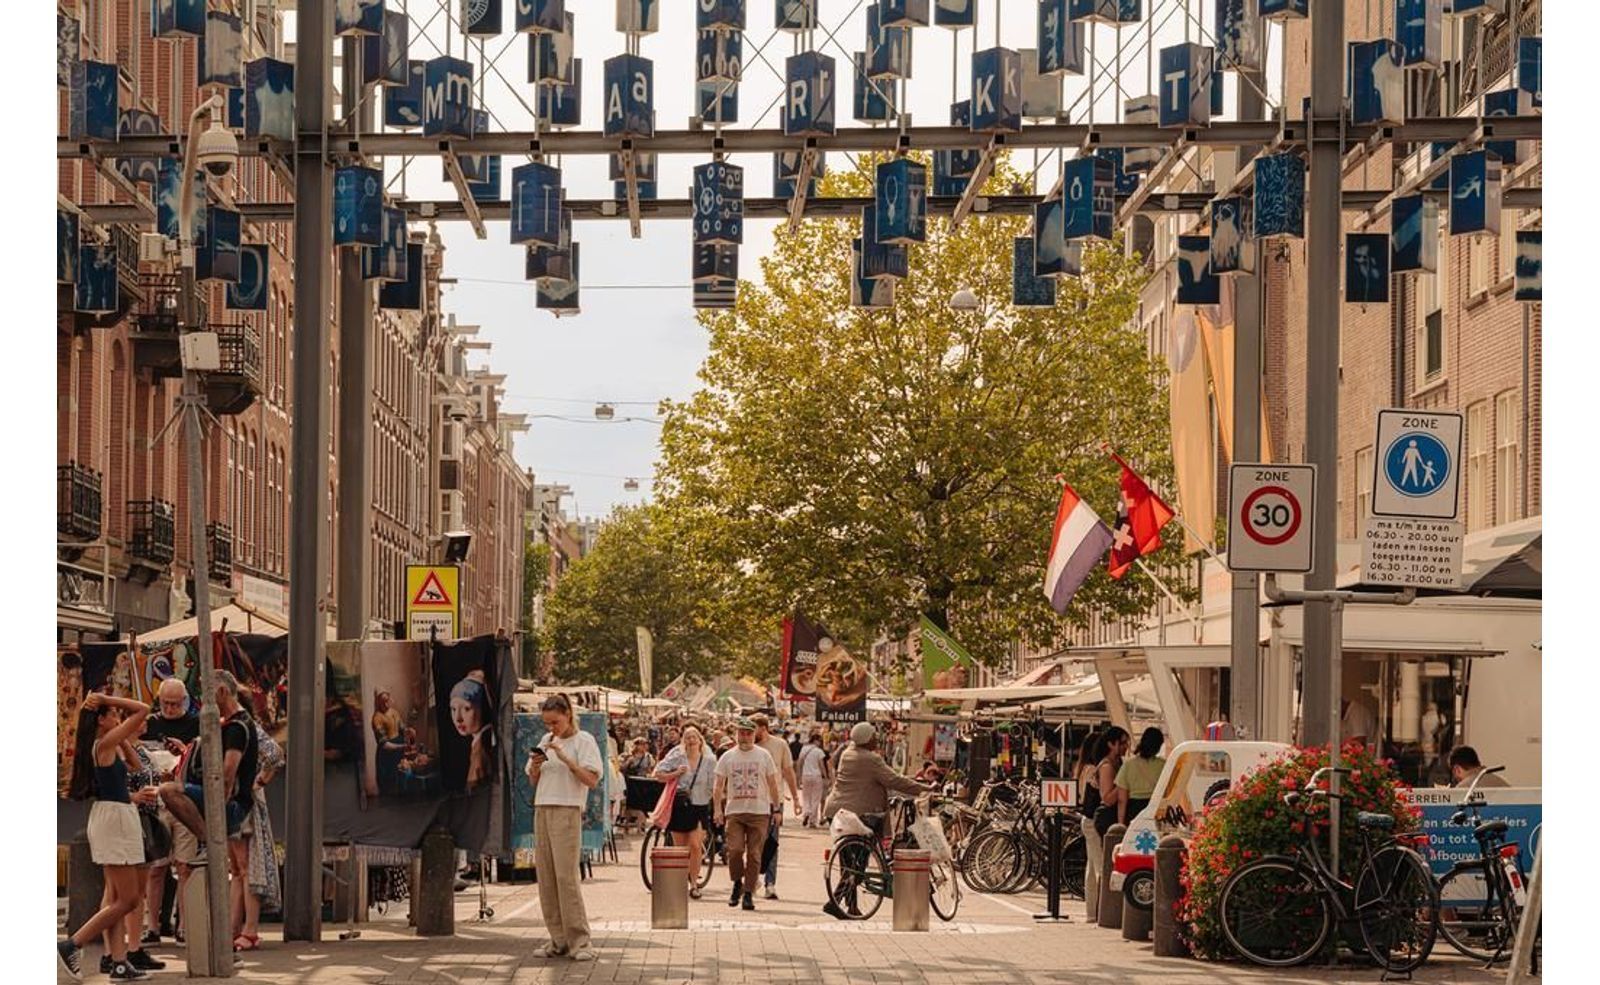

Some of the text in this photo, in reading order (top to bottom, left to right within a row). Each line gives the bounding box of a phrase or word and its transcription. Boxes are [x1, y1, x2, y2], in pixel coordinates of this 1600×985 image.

[1402, 418, 1438, 429] ZONE
[1255, 471, 1289, 482] ZONE
[1253, 504, 1290, 527] 30
[1377, 521, 1392, 529] ma
[1396, 522, 1413, 531] t/m
[1367, 531, 1397, 540] 06.30
[1407, 532, 1438, 542] 20.00
[1373, 542, 1400, 550] laden
[1419, 543, 1451, 553] lossen
[1373, 552, 1429, 562] toegestaan
[1370, 562, 1400, 571] 06.30
[1411, 564, 1437, 573] 11.00
[1367, 572, 1394, 582] 16.30
[1404, 574, 1432, 583] 21.00
[1435, 577, 1453, 585] uur
[821, 711, 859, 720] Falafel
[1048, 783, 1069, 803] IN
[1408, 794, 1451, 803] ERREIN
[1423, 820, 1438, 828] en
[1448, 835, 1467, 844] tot
